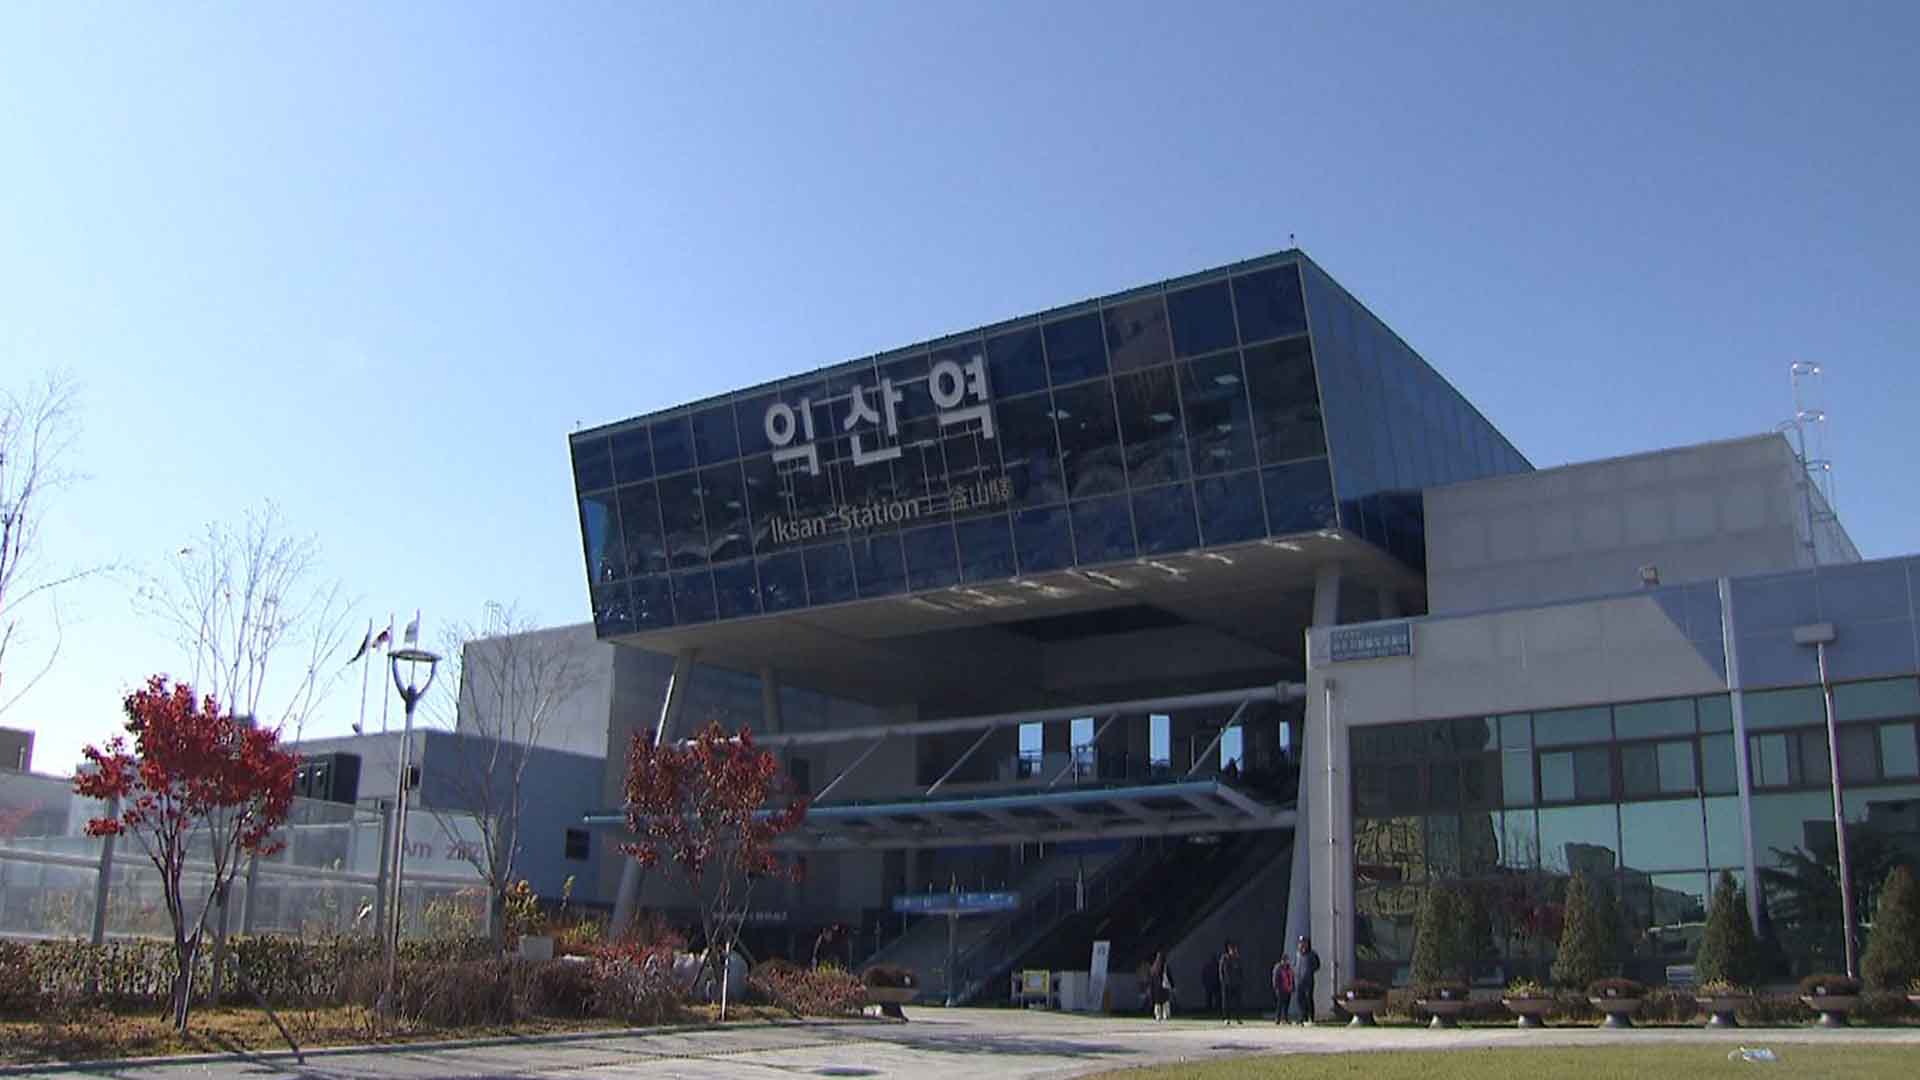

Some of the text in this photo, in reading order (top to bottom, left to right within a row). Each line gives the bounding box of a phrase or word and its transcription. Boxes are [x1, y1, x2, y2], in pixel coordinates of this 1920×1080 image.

[765, 355, 994, 475] 익산역
[771, 497, 921, 544] Iksan Station
